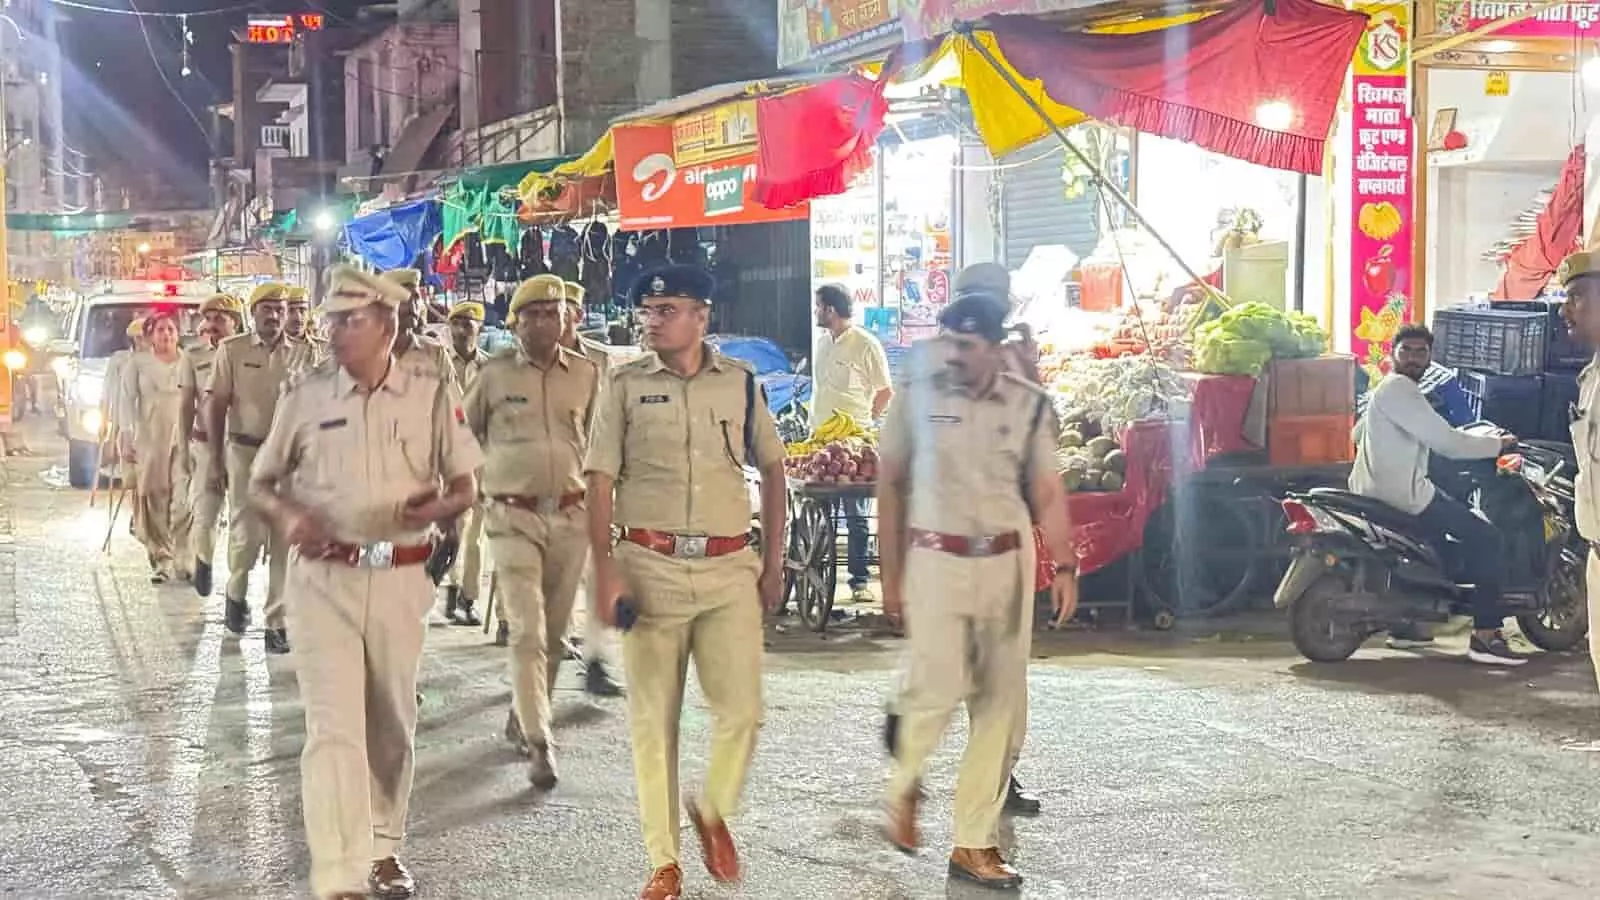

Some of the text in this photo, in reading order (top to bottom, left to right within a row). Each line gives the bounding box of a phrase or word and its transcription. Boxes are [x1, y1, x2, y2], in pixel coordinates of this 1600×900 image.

[1372, 33, 1398, 61] KS
[1365, 108, 1400, 125] माता
[706, 177, 737, 200] oppo
